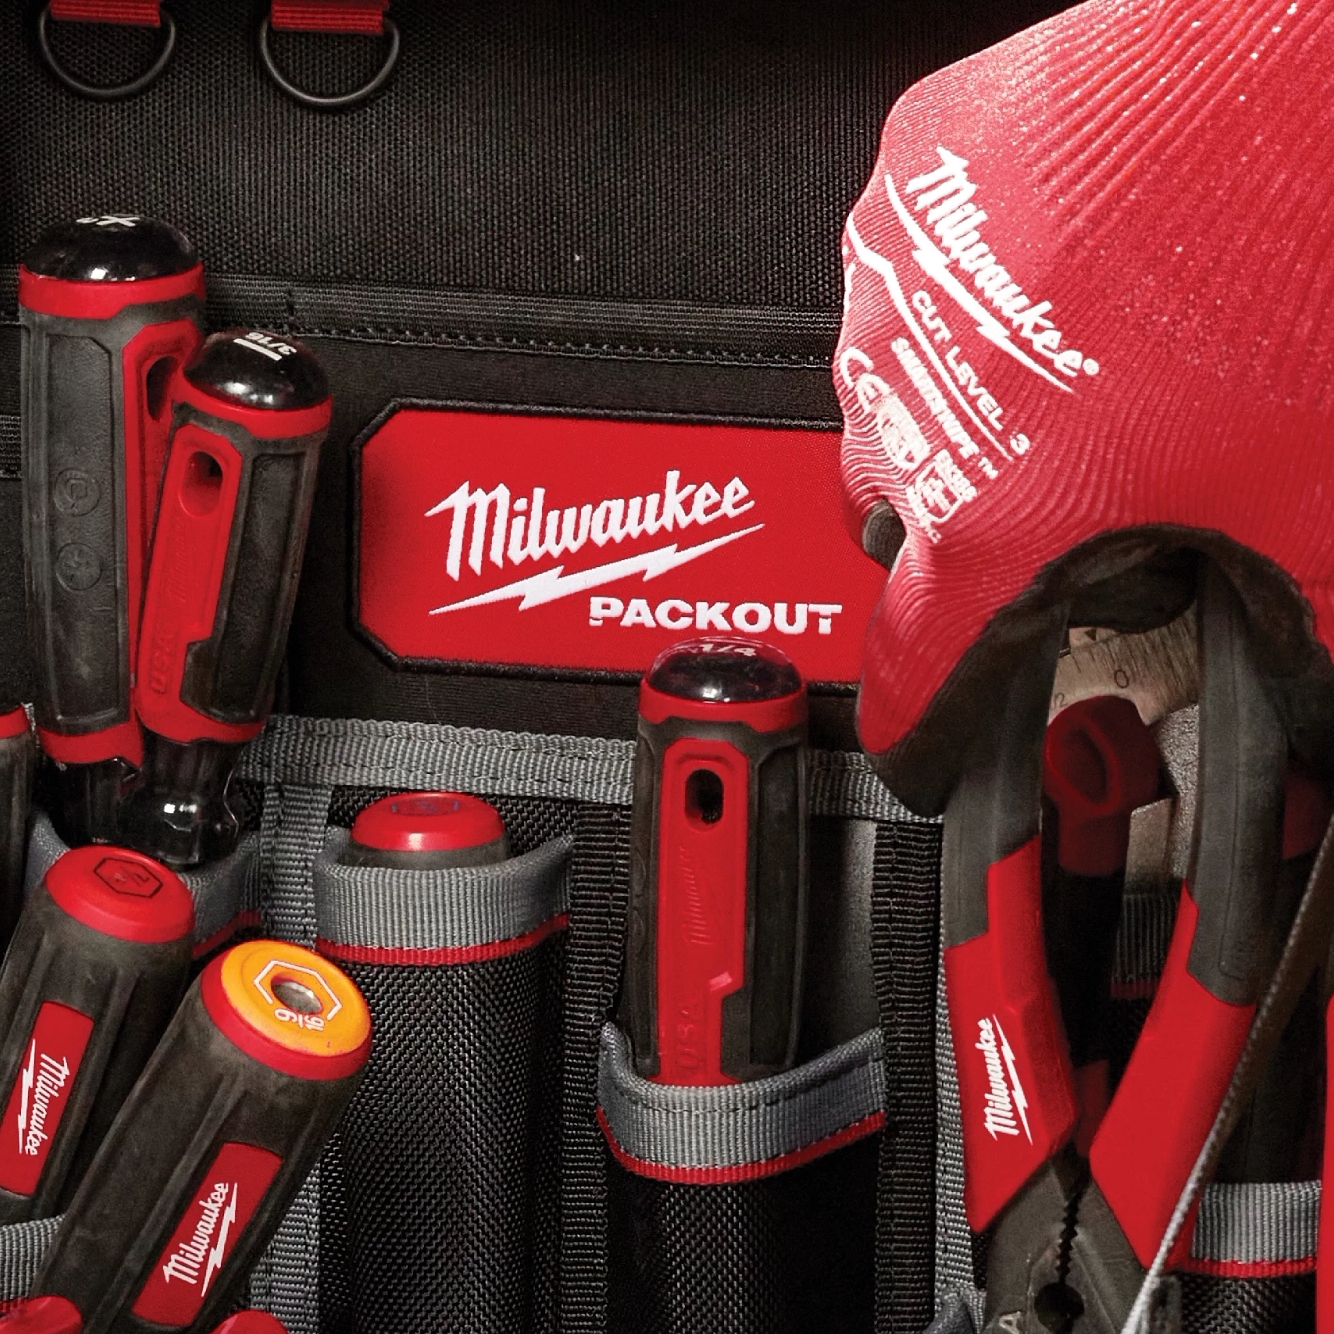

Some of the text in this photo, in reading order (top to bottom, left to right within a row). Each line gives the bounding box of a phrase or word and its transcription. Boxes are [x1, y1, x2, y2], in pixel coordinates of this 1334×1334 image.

[912, 289, 1031, 455] CUT LEVEL 3
[426, 469, 756, 581] Milwaukee
[589, 596, 843, 635] PACKOUT
[700, 643, 757, 656] 1/4
[274, 1007, 325, 1032] 9/16
[25, 1053, 70, 1156] Milwaukee
[974, 1017, 1020, 1141] Milwaukee
[162, 1182, 229, 1285] Milwaukee
